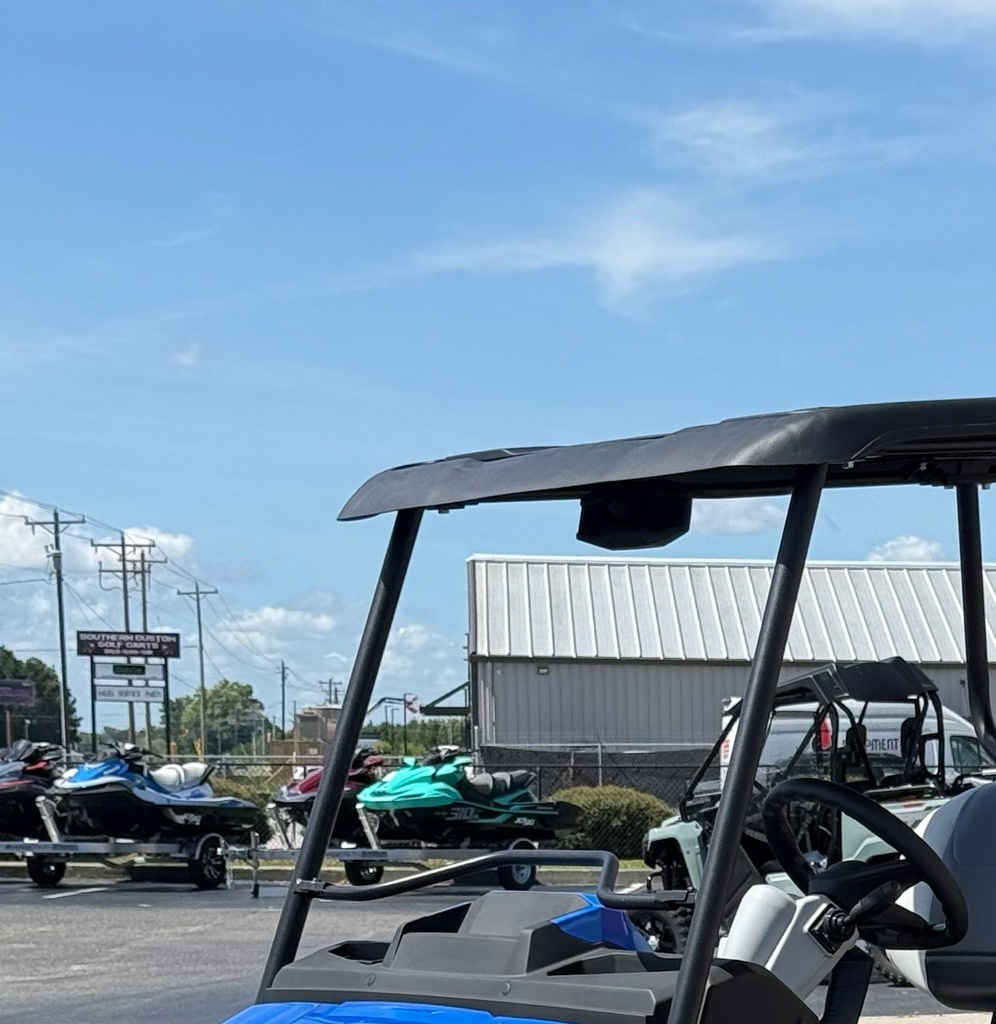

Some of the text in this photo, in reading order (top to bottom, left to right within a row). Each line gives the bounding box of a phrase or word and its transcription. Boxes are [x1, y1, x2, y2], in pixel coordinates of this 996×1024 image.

[79, 633, 177, 643] SOUTHERN CUSTOM
[97, 641, 159, 650] GOLF CARTS
